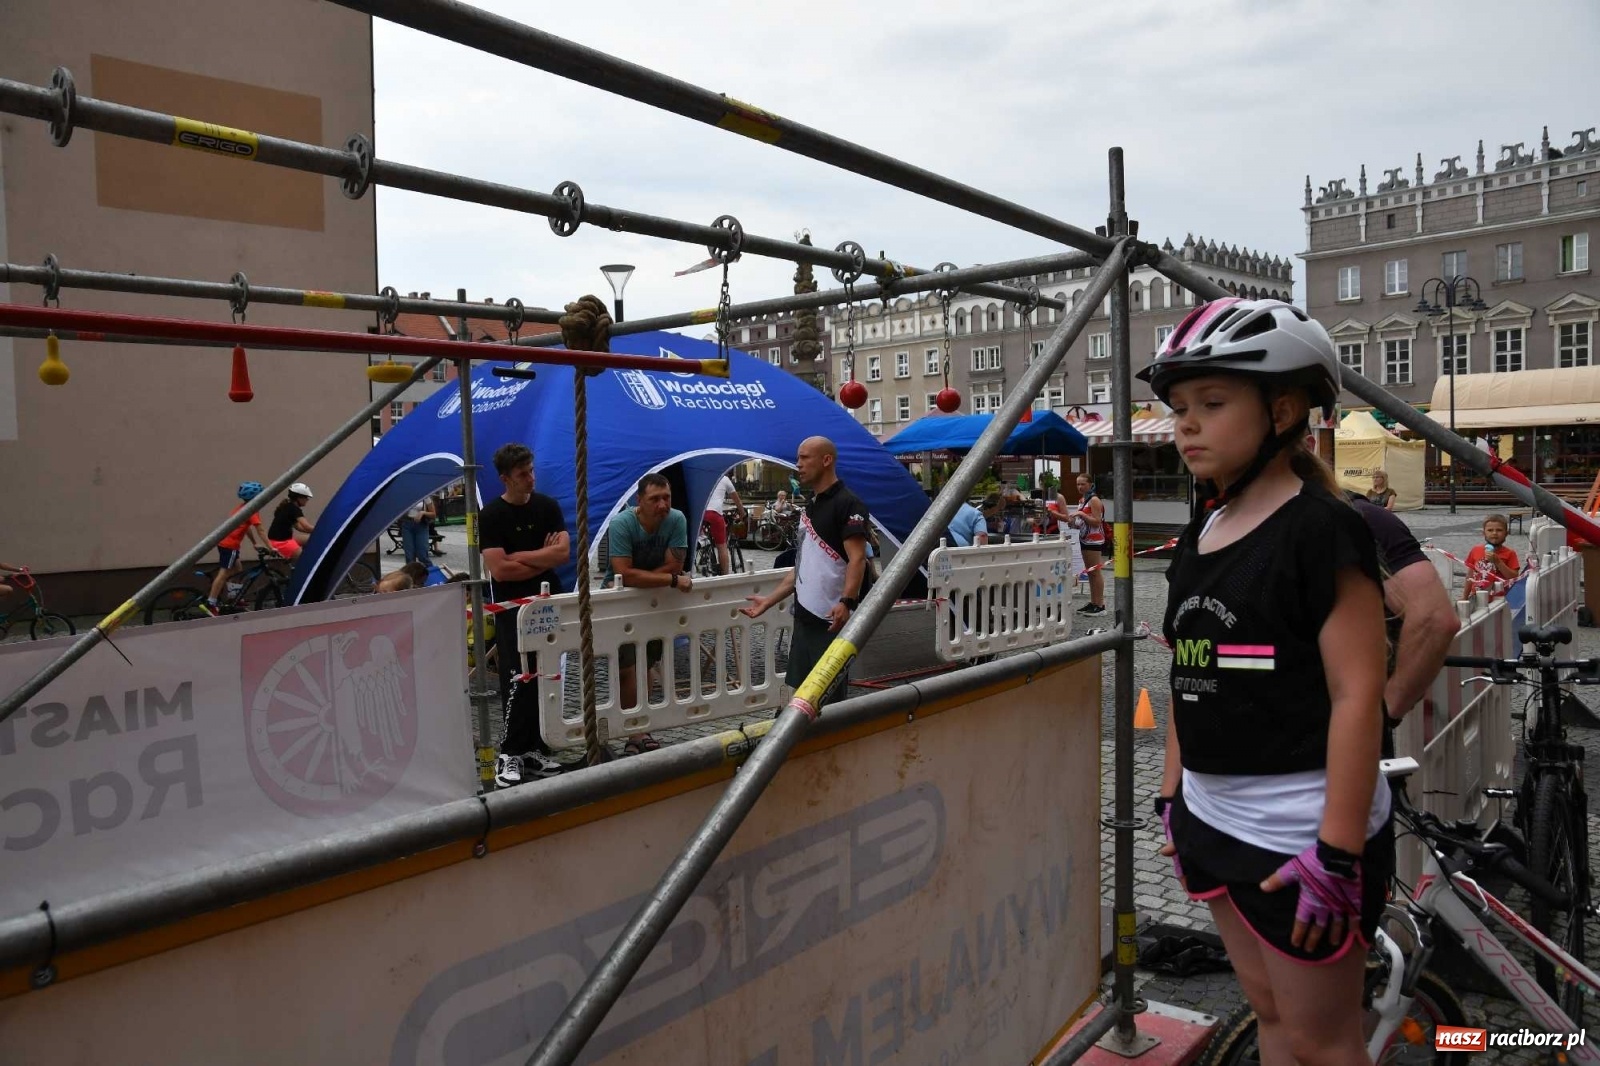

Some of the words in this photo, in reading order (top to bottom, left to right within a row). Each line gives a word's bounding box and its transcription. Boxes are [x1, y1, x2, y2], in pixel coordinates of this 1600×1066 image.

[180, 132, 253, 155] ERIGO
[659, 378, 767, 397] Wodociągi
[671, 394, 777, 410] Raciborskie
[818, 540, 840, 562] OCR
[1201, 595, 1238, 629] ACTIVE
[1176, 638, 1211, 668] NYC
[1190, 678, 1219, 693] DONE
